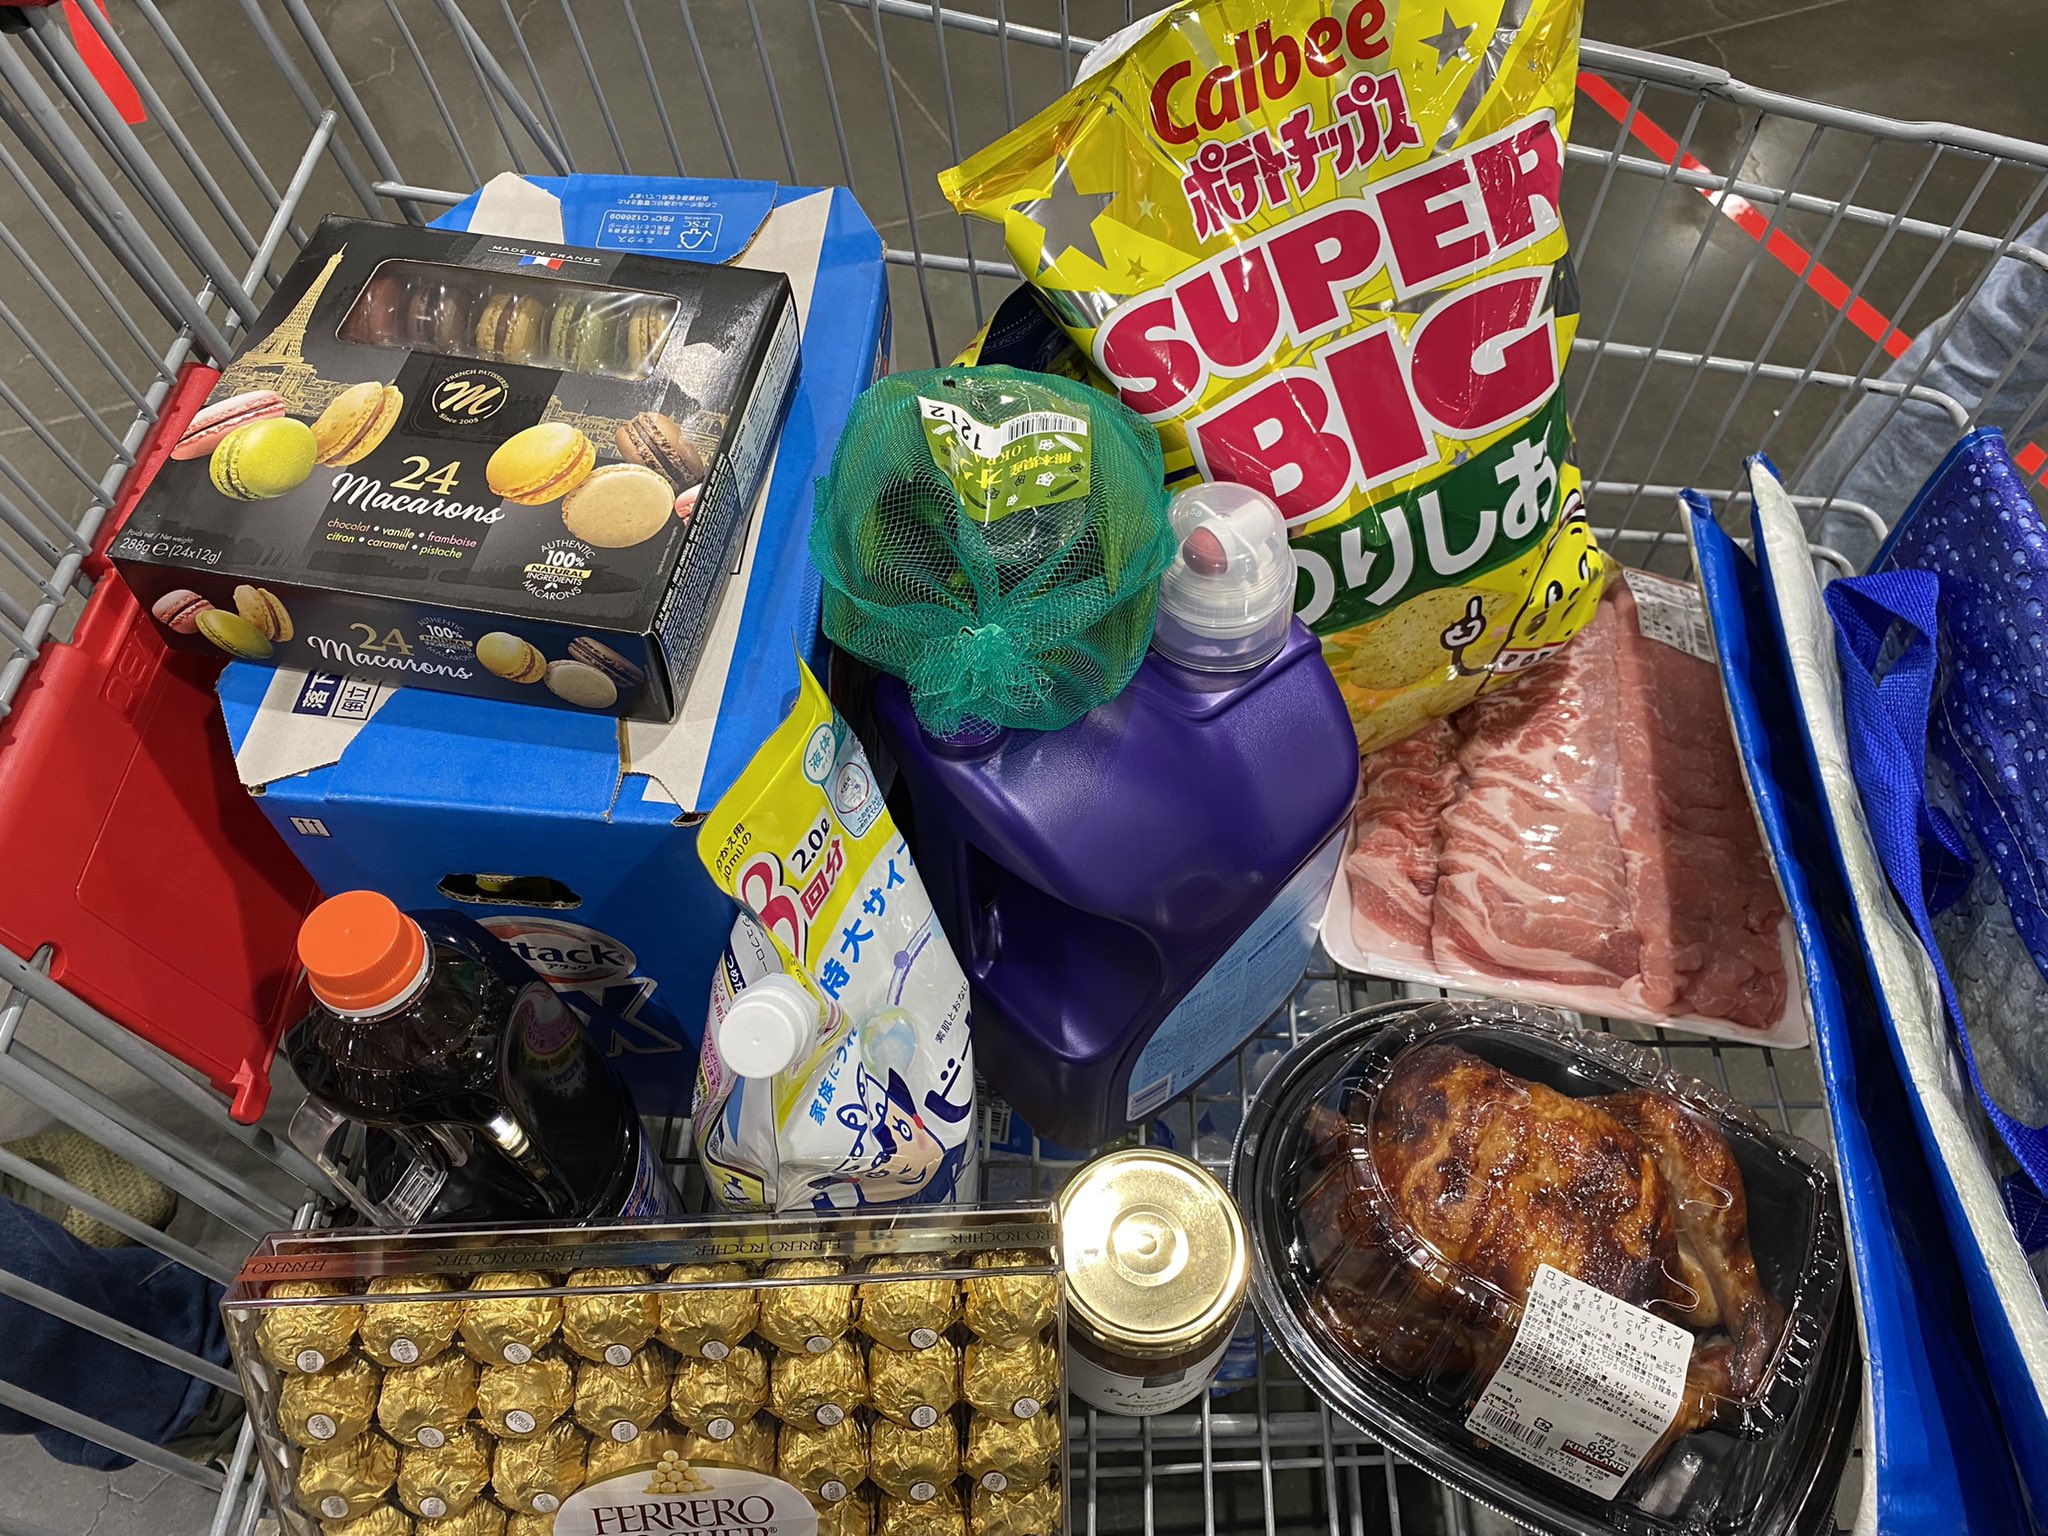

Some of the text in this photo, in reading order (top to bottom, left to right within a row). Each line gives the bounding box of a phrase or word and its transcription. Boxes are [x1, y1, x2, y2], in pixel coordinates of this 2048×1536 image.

[1150, 0, 1391, 145] Calbee
[1183, 69, 1423, 242] ポテトチップス
[616, 235, 655, 244] ミックス
[492, 245, 527, 254] MADE
[549, 252, 601, 264] FRANCE
[1102, 110, 1564, 422] SUPER
[445, 369, 477, 382] FRENCH
[1196, 274, 1556, 522] BIG
[458, 417, 479, 425] 2005
[927, 404, 982, 451] 1212
[389, 454, 462, 496] 24
[1008, 451, 1072, 477] 熊本県産
[331, 471, 506, 525] Macarons
[325, 531, 464, 560] citron caramel pistache
[327, 517, 478, 549] chocolat vanille framboise
[120, 537, 152, 555] 288g
[168, 543, 223, 565] (24x12g)
[541, 539, 597, 560] AUTHENTIC
[545, 549, 586, 569] 100%
[526, 571, 584, 587] INGREDIENTS
[530, 565, 587, 579] NATURAL
[522, 579, 583, 601] MACARONS
[349, 622, 416, 657] 24
[425, 624, 464, 640] 100%
[306, 634, 474, 681] Macarons
[808, 731, 835, 772] 液体
[546, 962, 588, 971] アタック
[693, 1238, 842, 1258] FERRERO ROCHER
[950, 1230, 1022, 1246] ROCHER
[252, 1259, 327, 1275] FERRERO
[435, 1250, 584, 1268] FERRERO ROCHER
[1542, 1278, 1681, 1350] ROTISSERIE CHICKEN
[1544, 1269, 1683, 1341] ロティサリーチキン
[1565, 1440, 1627, 1473] KIRKLAND
[1586, 1439, 1616, 1460] 699
[1598, 1437, 1617, 1450] 647
[590, 1496, 776, 1536] FERRERO
